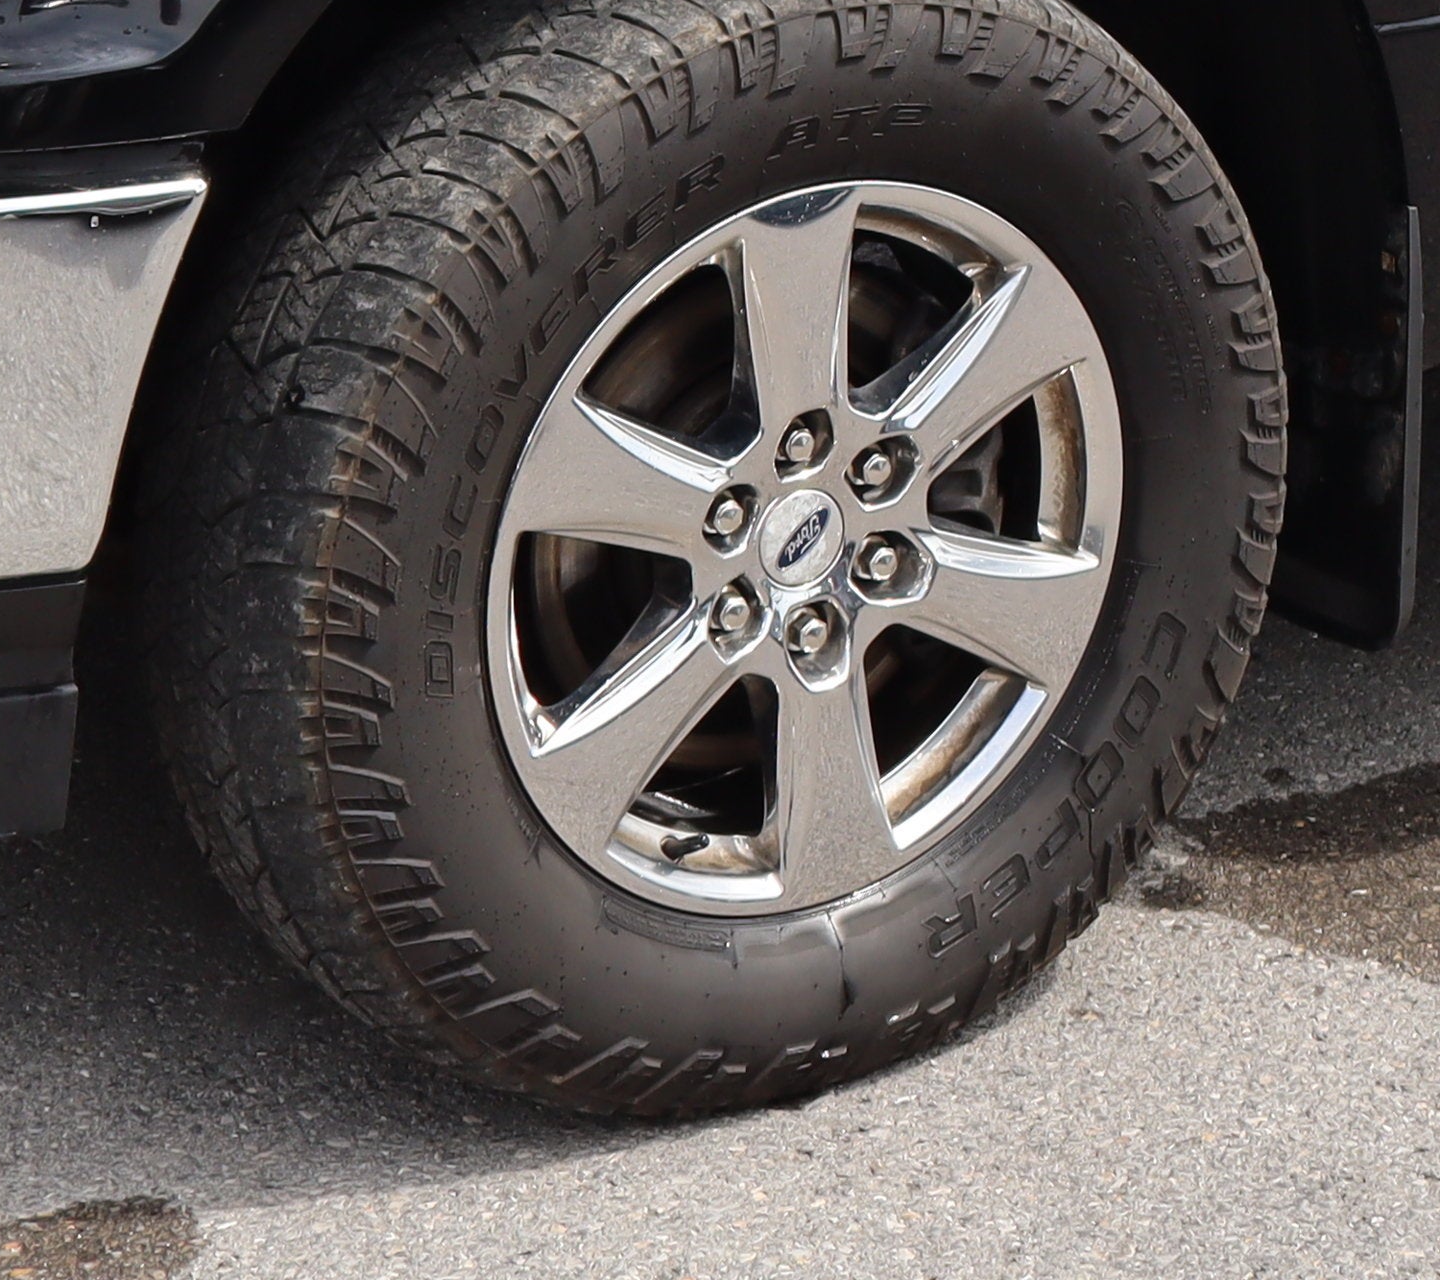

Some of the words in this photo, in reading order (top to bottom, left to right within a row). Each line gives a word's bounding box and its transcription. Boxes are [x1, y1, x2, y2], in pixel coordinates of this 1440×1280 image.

[424, 153, 728, 700] DISCOVERER
[784, 514, 821, 562] Ford
[920, 610, 1189, 960] COOPER
